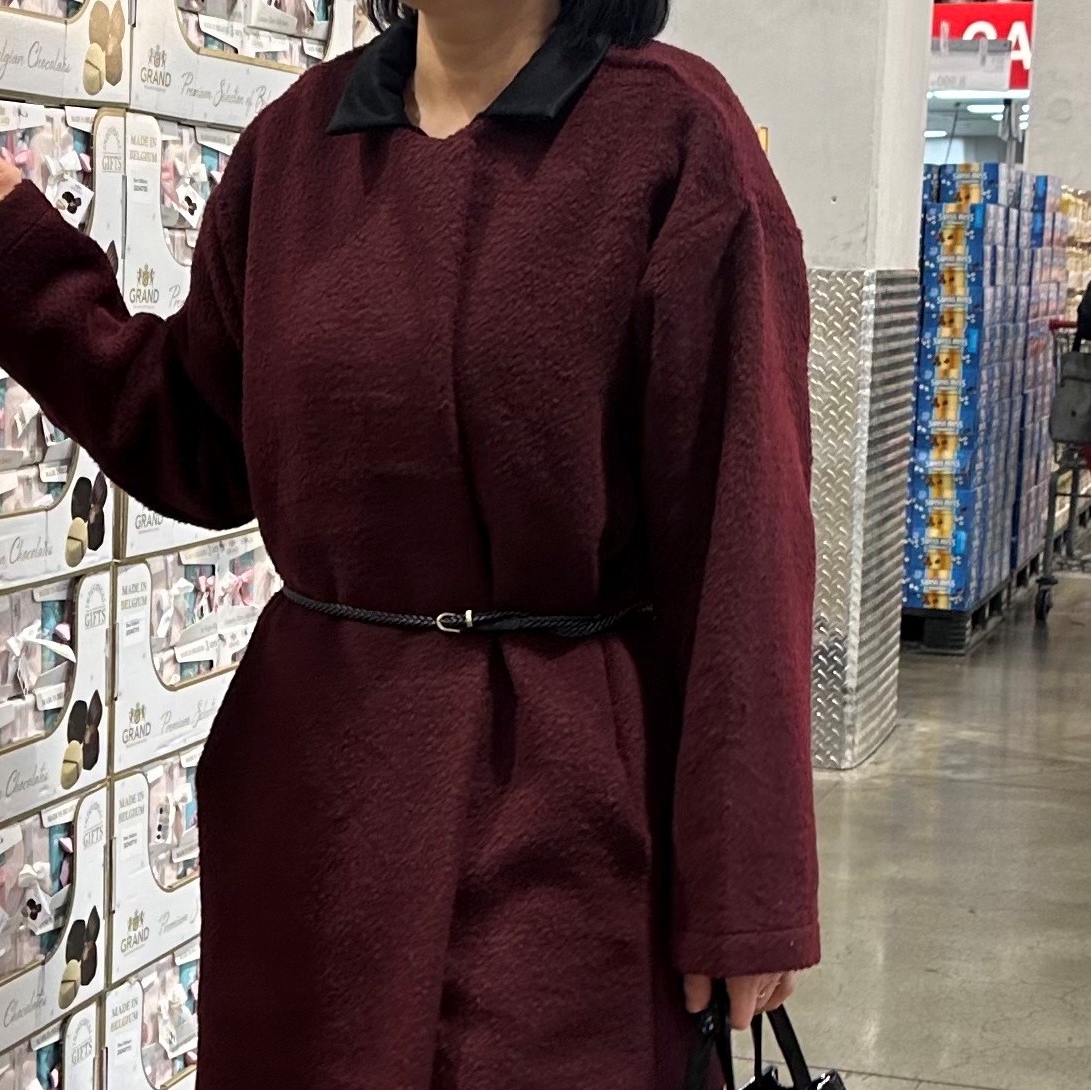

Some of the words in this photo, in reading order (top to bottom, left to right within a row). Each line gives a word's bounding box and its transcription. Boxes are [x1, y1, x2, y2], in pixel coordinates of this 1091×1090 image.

[140, 67, 171, 88] GRAND
[101, 156, 123, 172] GIFTS
[129, 288, 159, 304] GRAND
[84, 610, 106, 628] GIFTS
[122, 722, 151, 744] GRAND
[83, 827, 103, 847] GIFTS
[120, 926, 150, 953] GRAND
[72, 1041, 93, 1065] GIFTS
